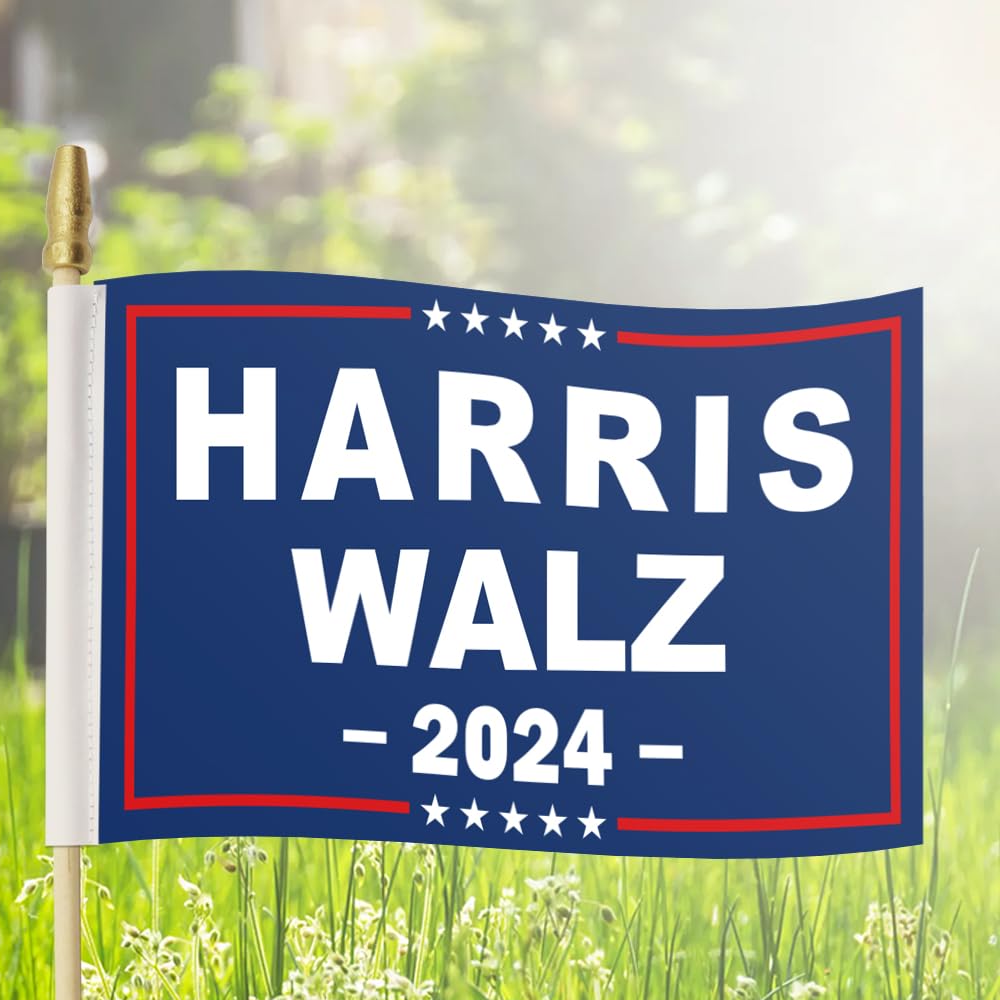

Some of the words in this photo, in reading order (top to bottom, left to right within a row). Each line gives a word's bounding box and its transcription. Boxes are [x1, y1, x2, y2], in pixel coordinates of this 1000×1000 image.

[175, 366, 855, 514] HARRIS
[290, 547, 727, 674] WALZ
[411, 702, 614, 787] 2024
